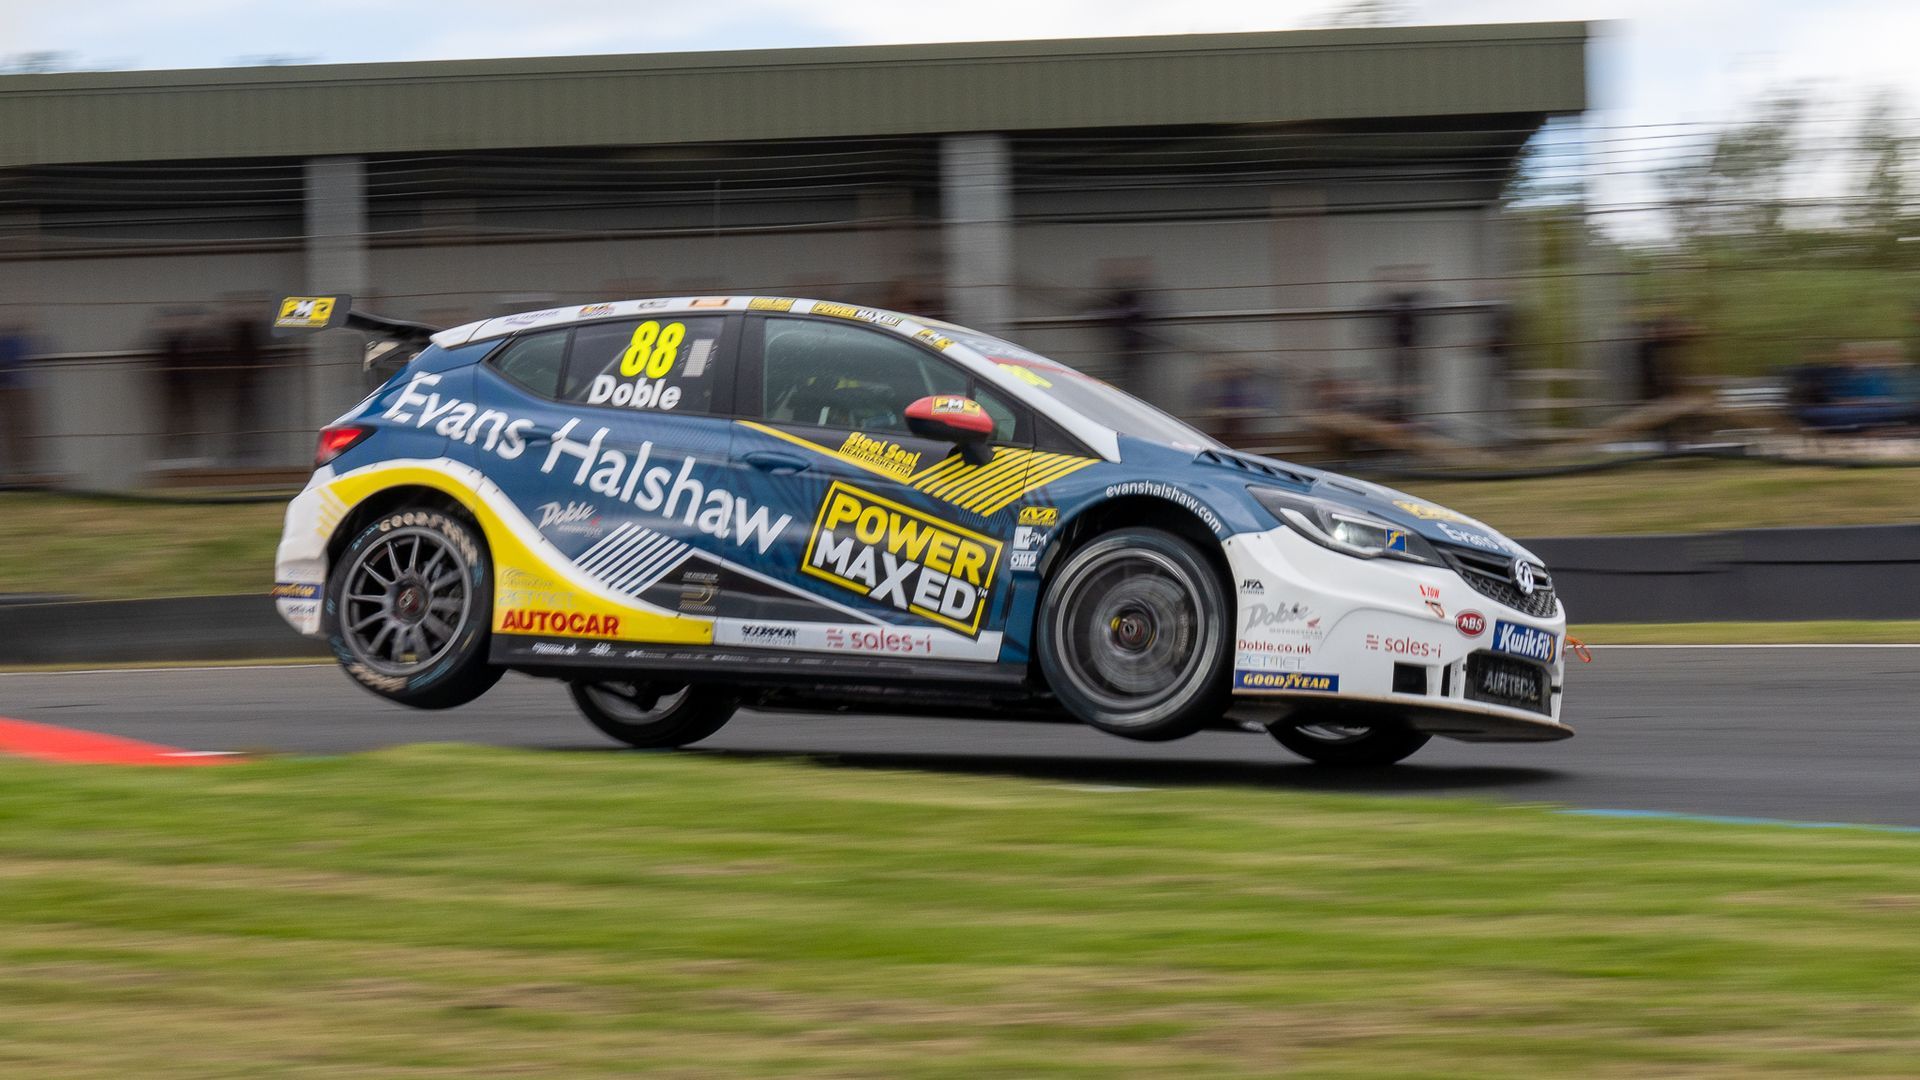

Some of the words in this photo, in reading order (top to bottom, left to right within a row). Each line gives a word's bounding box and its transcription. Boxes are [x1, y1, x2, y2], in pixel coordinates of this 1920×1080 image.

[814, 303, 858, 321] POWER
[620, 320, 686, 379] 88
[587, 374, 682, 411] Doble
[845, 431, 889, 456] Steel
[884, 443, 922, 467] Seal
[382, 371, 536, 460] Evans
[540, 417, 793, 555] Halshaw
[535, 500, 599, 530] Doble
[1105, 480, 1222, 534] evanshalshaw.com
[825, 493, 987, 585] POWER
[1010, 553, 1037, 568] OMP
[812, 529, 976, 620] MAXED
[1240, 579, 1264, 589] JFA
[1426, 586, 1440, 600] TOW
[501, 609, 620, 635] AUTOCAR
[1240, 602, 1314, 634] Doble
[1460, 615, 1483, 631] ABS
[851, 629, 932, 654] sales-i
[1238, 639, 1312, 654] Doble.co.uk
[1385, 636, 1442, 658] sales-i
[1243, 672, 1331, 690] GOODYEAR
